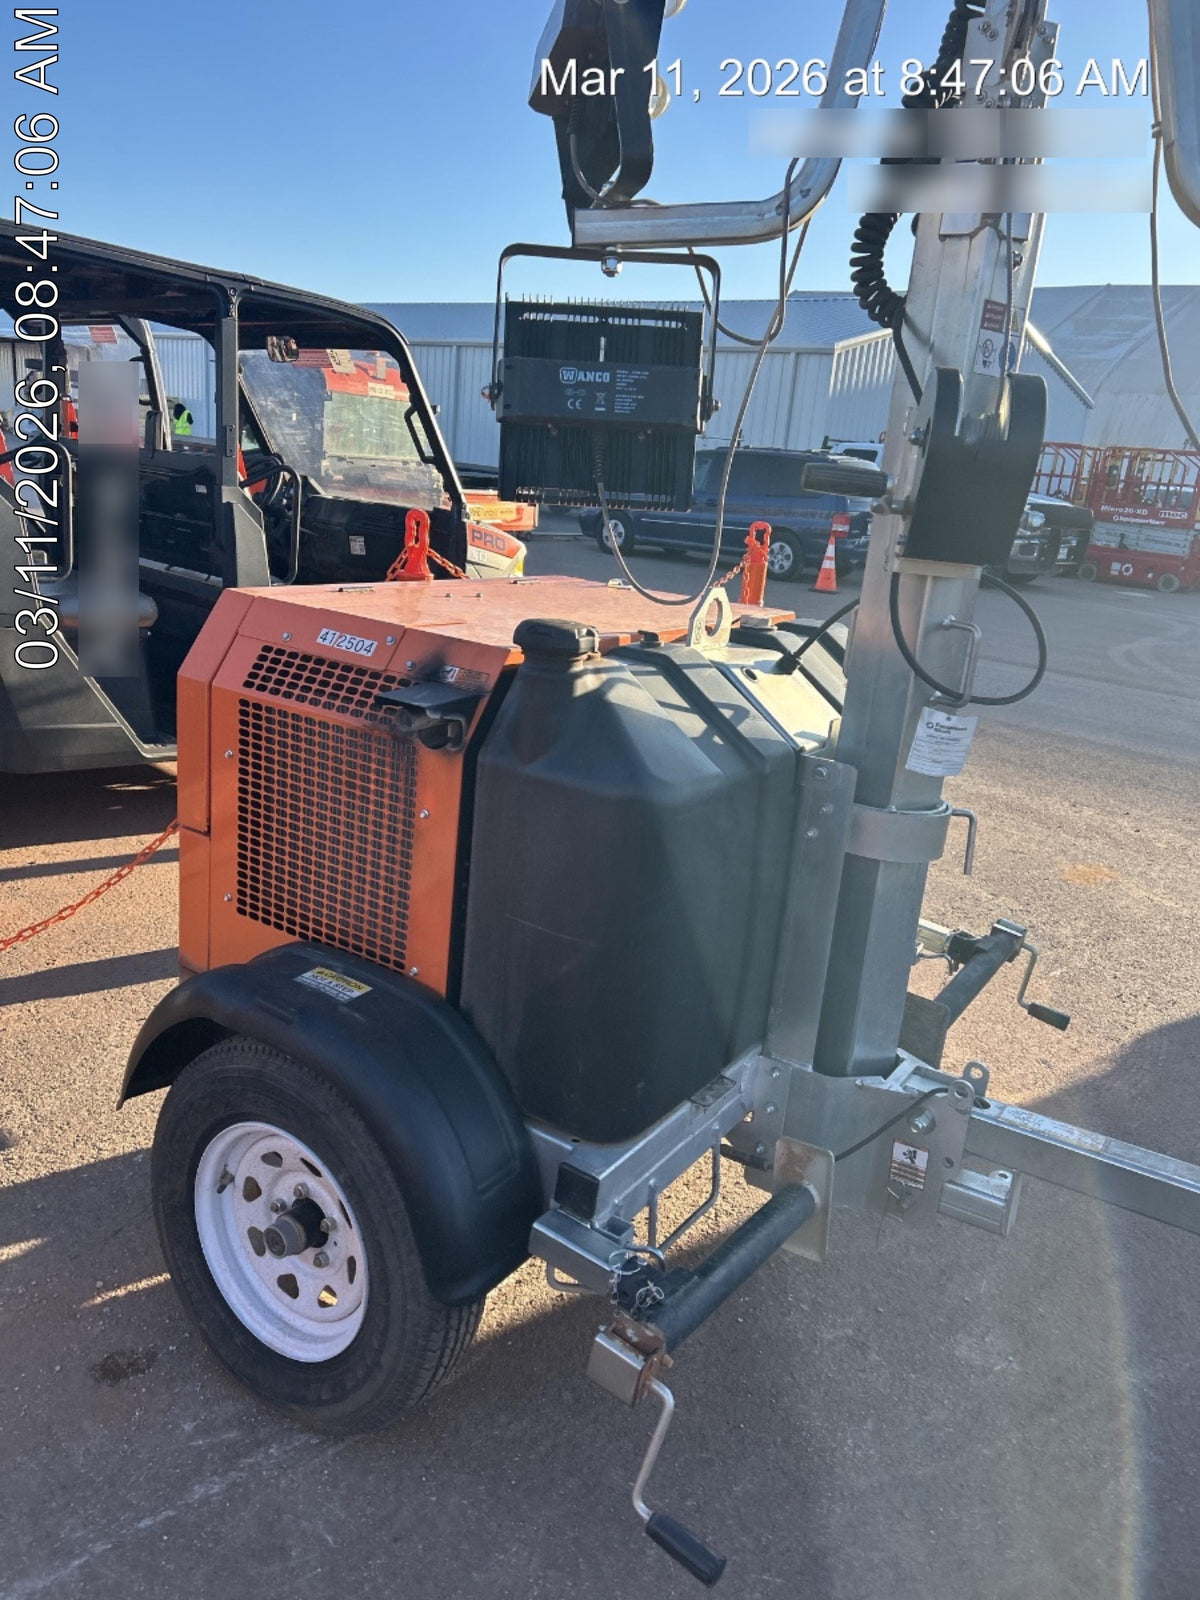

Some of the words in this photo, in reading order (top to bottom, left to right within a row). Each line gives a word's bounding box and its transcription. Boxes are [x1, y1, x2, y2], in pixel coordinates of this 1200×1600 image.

[560, 367, 611, 384] WANCO
[471, 528, 506, 551] PRO
[319, 630, 375, 655] 412504
